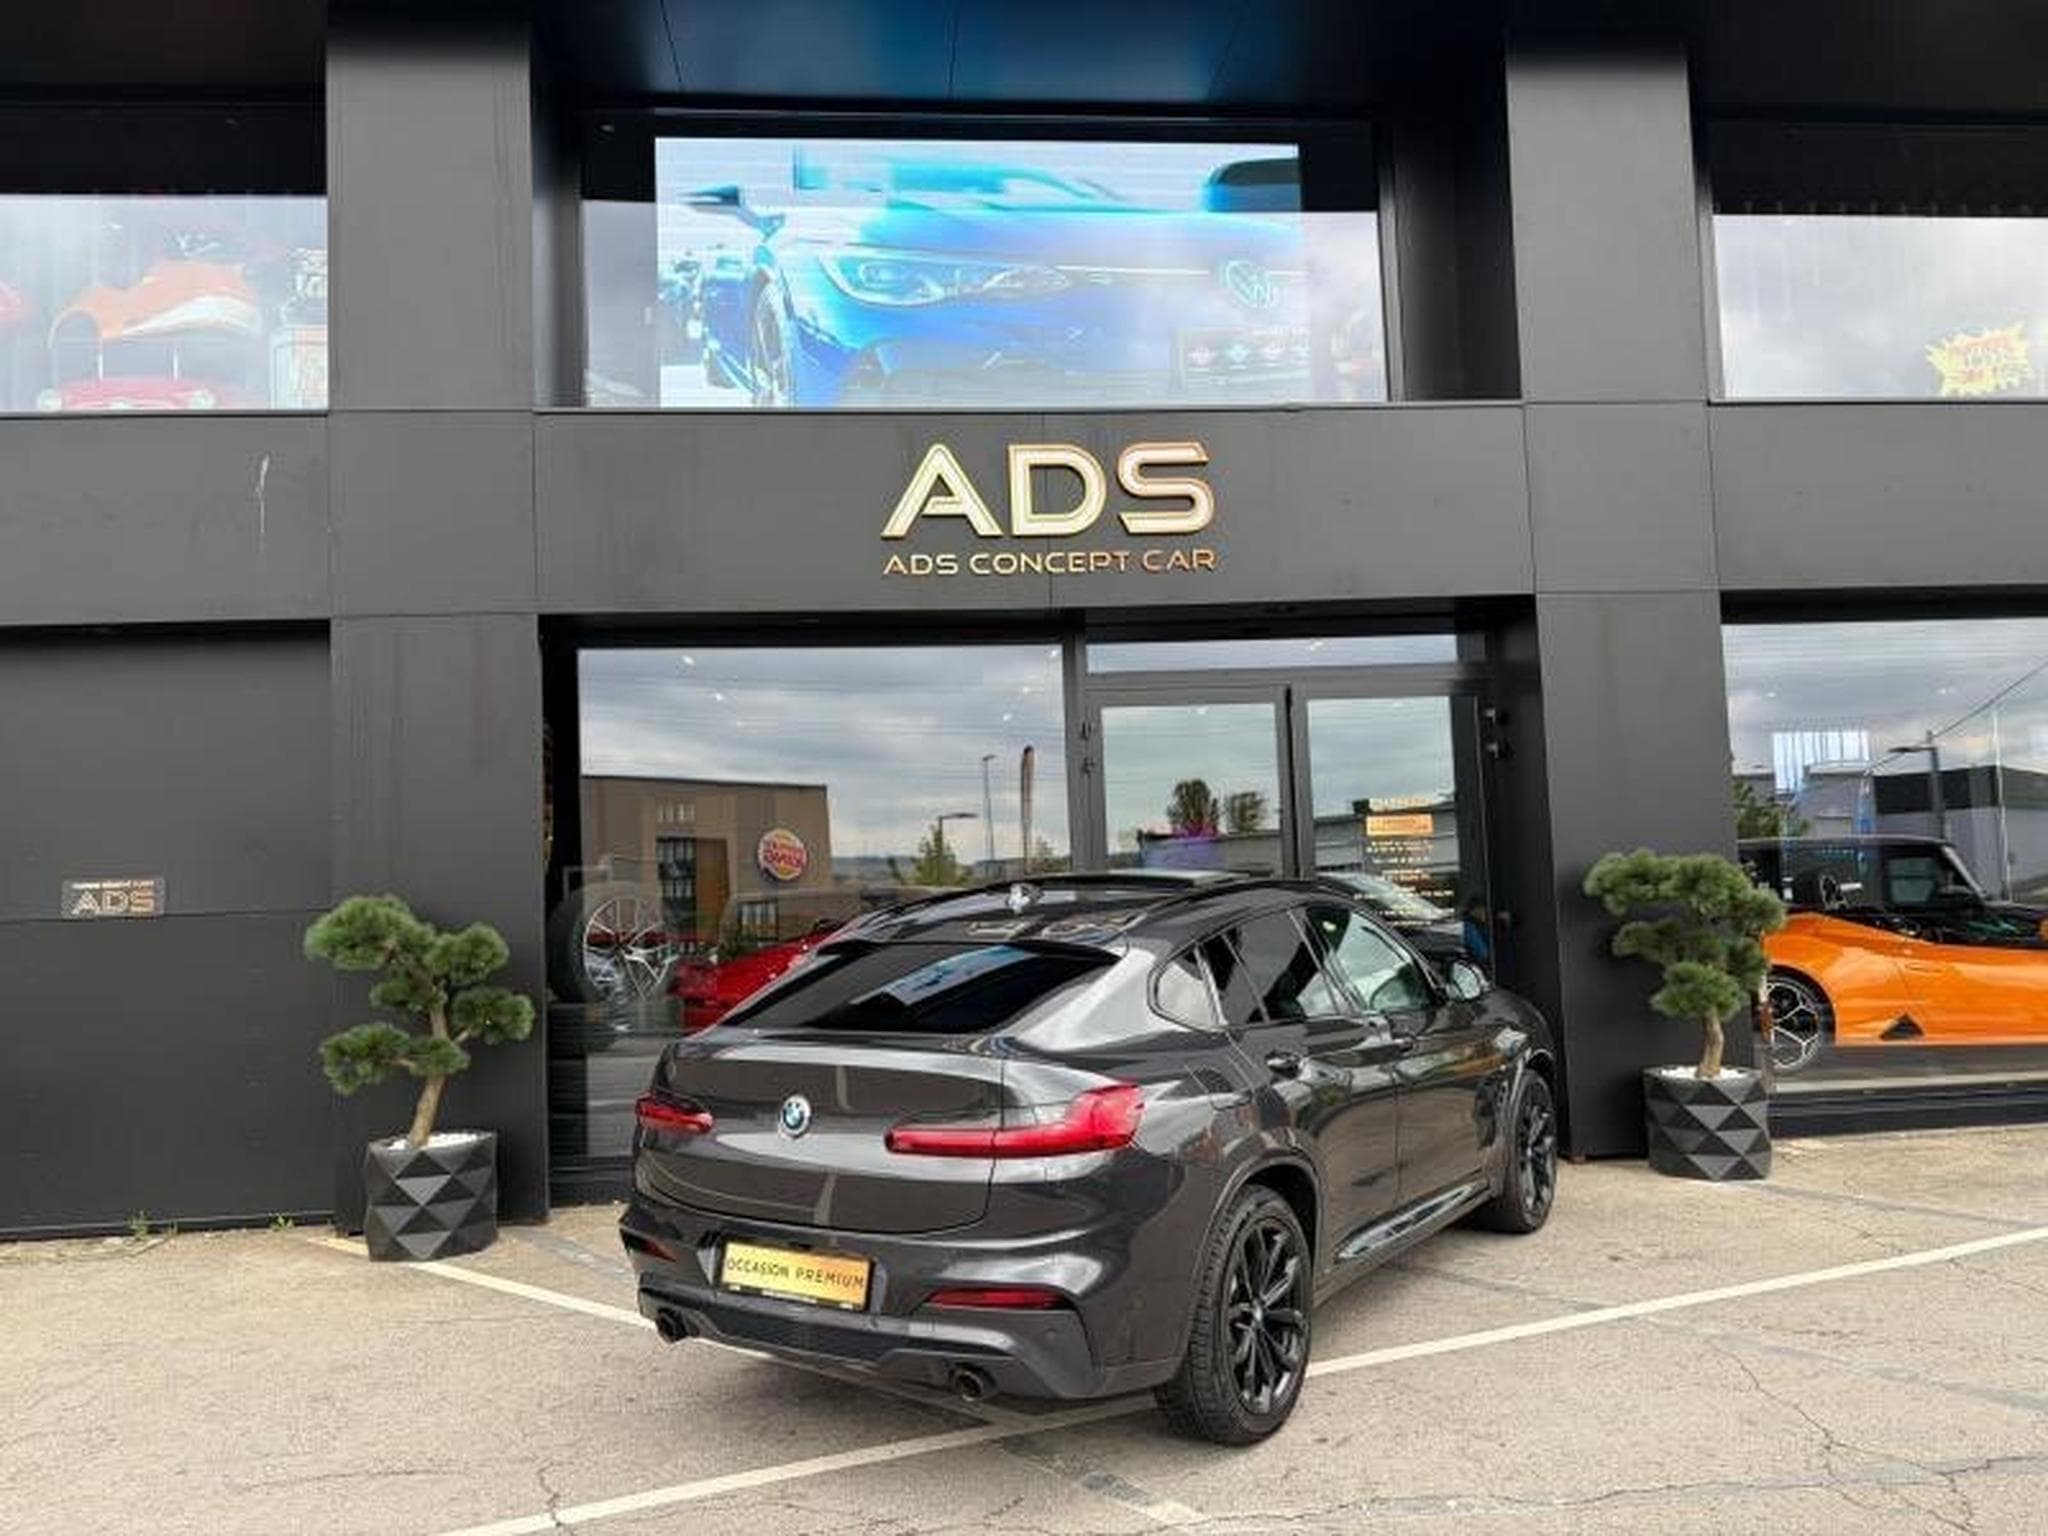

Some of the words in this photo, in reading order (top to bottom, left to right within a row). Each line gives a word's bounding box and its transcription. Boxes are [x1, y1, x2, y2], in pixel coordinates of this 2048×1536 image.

[880, 442, 1215, 539] ADS
[883, 553, 959, 576] ADS
[969, 551, 1131, 575] CONCEPT
[1143, 548, 1217, 573] CAR
[71, 890, 155, 915] ADS
[726, 1257, 790, 1278] OCCASION
[795, 1266, 865, 1289] PREMIUM
